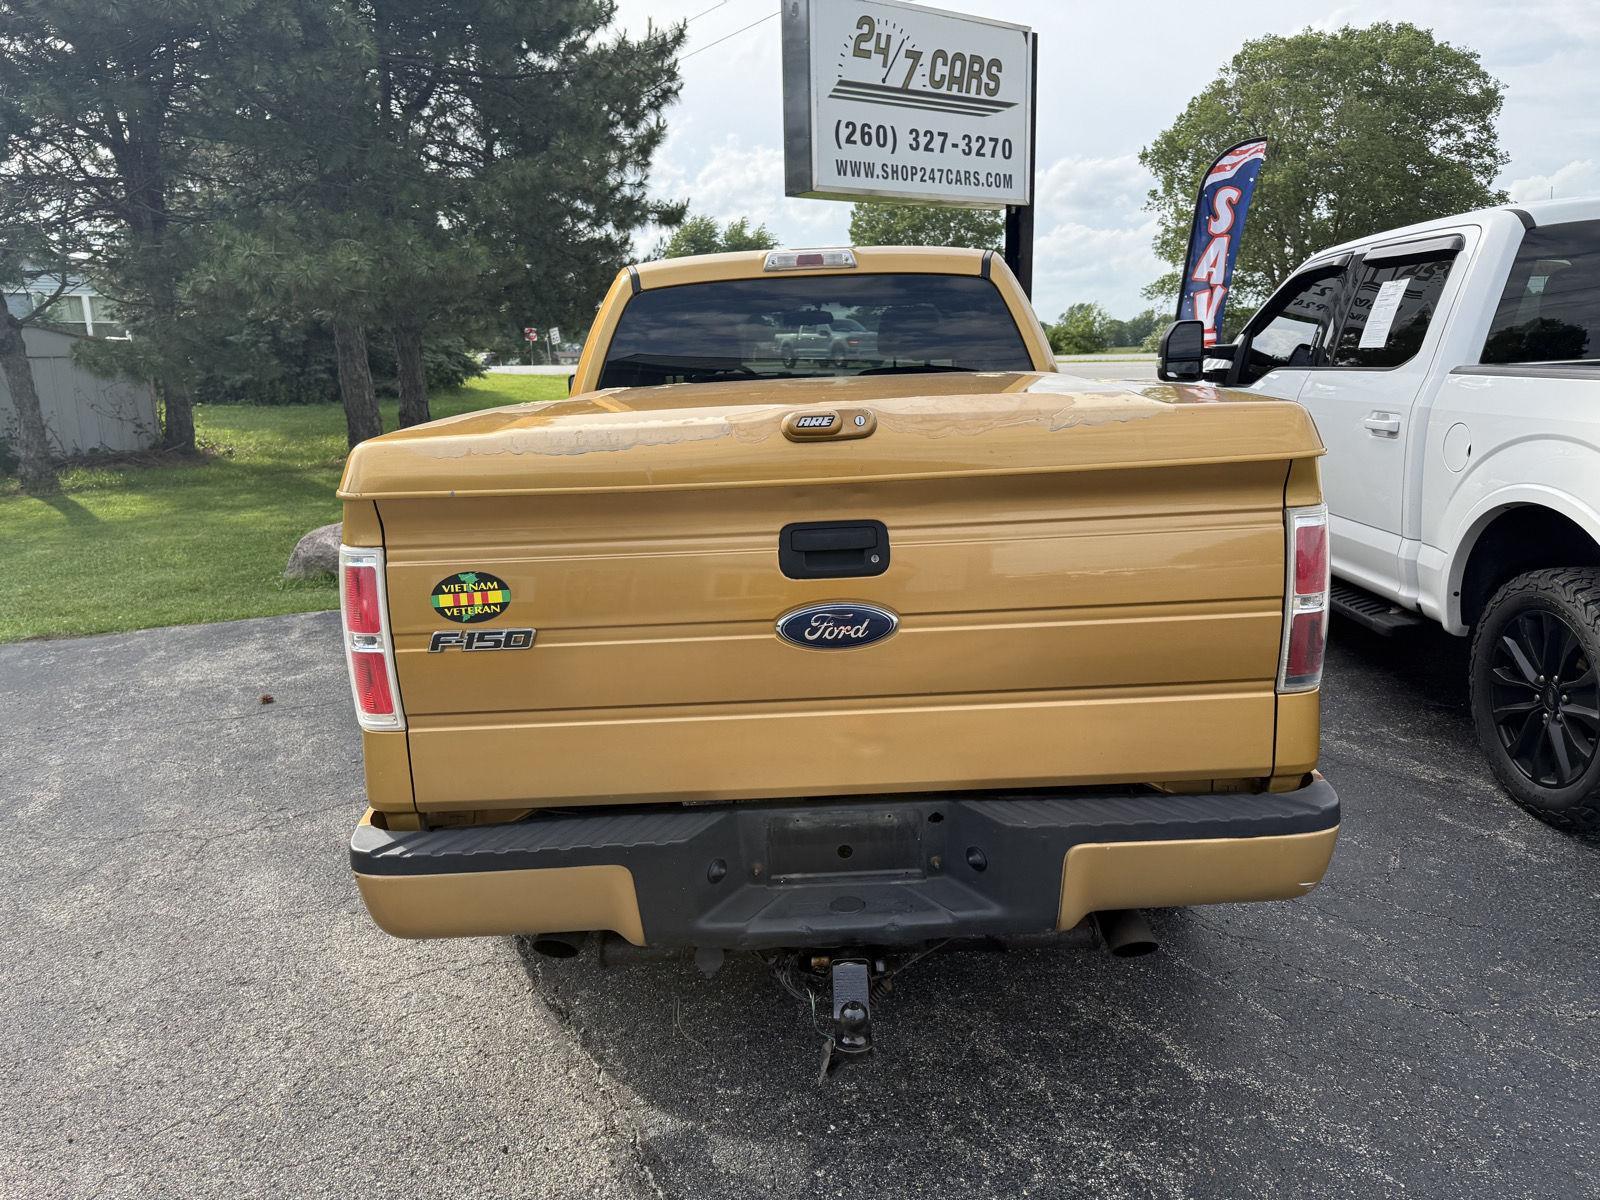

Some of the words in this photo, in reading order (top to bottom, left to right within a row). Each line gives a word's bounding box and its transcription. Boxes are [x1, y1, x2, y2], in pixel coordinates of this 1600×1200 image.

[852, 15, 923, 90] 24/7
[928, 48, 1002, 97] CARS
[834, 119, 897, 154] (260)
[908, 128, 1013, 160] 327-3270
[835, 159, 1013, 189] WWW.SHOP247CARS.COM
[441, 581, 498, 593] VIETNAM
[444, 604, 501, 617] VETERAN
[804, 613, 870, 640] Ford
[428, 629, 536, 653] F-150
